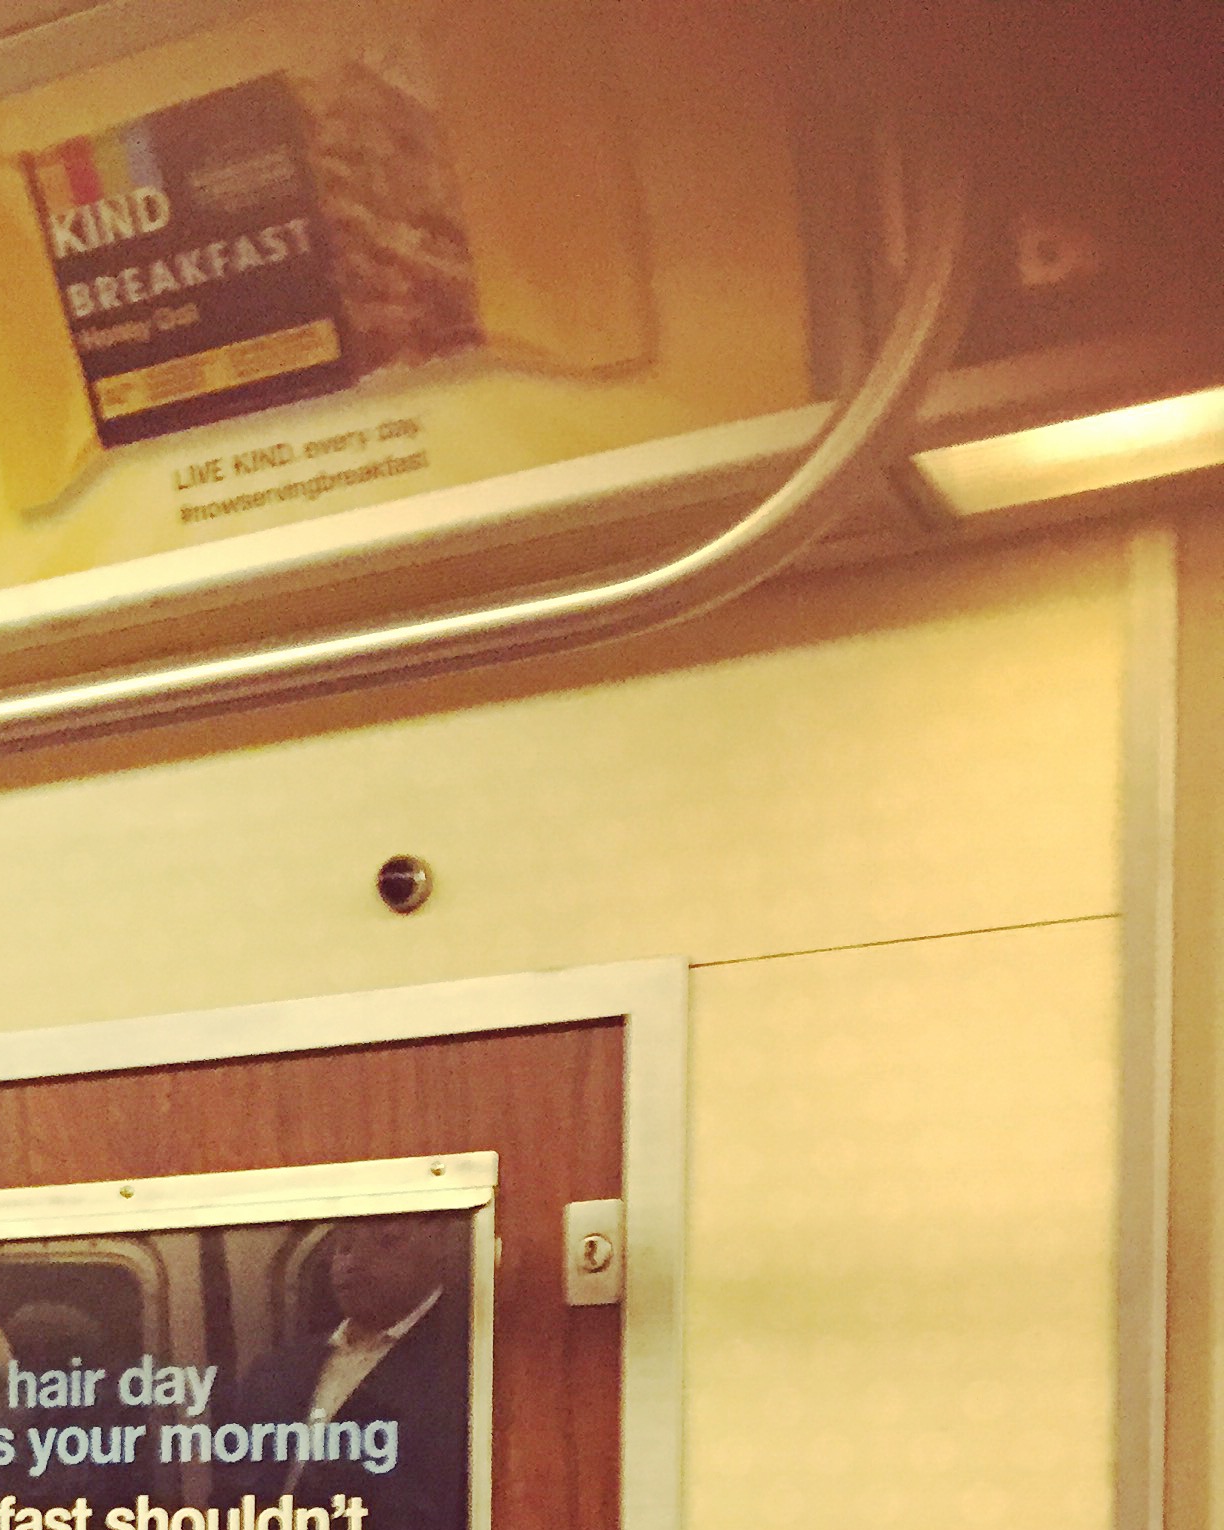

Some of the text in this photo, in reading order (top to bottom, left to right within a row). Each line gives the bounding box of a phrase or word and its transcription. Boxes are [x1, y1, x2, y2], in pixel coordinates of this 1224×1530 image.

[49, 187, 171, 258] KIND
[66, 218, 309, 317] BREAKFAST
[7, 1357, 105, 1408] hair
[119, 1354, 218, 1417] day
[28, 1424, 145, 1477] your
[159, 1408, 399, 1475] morning
